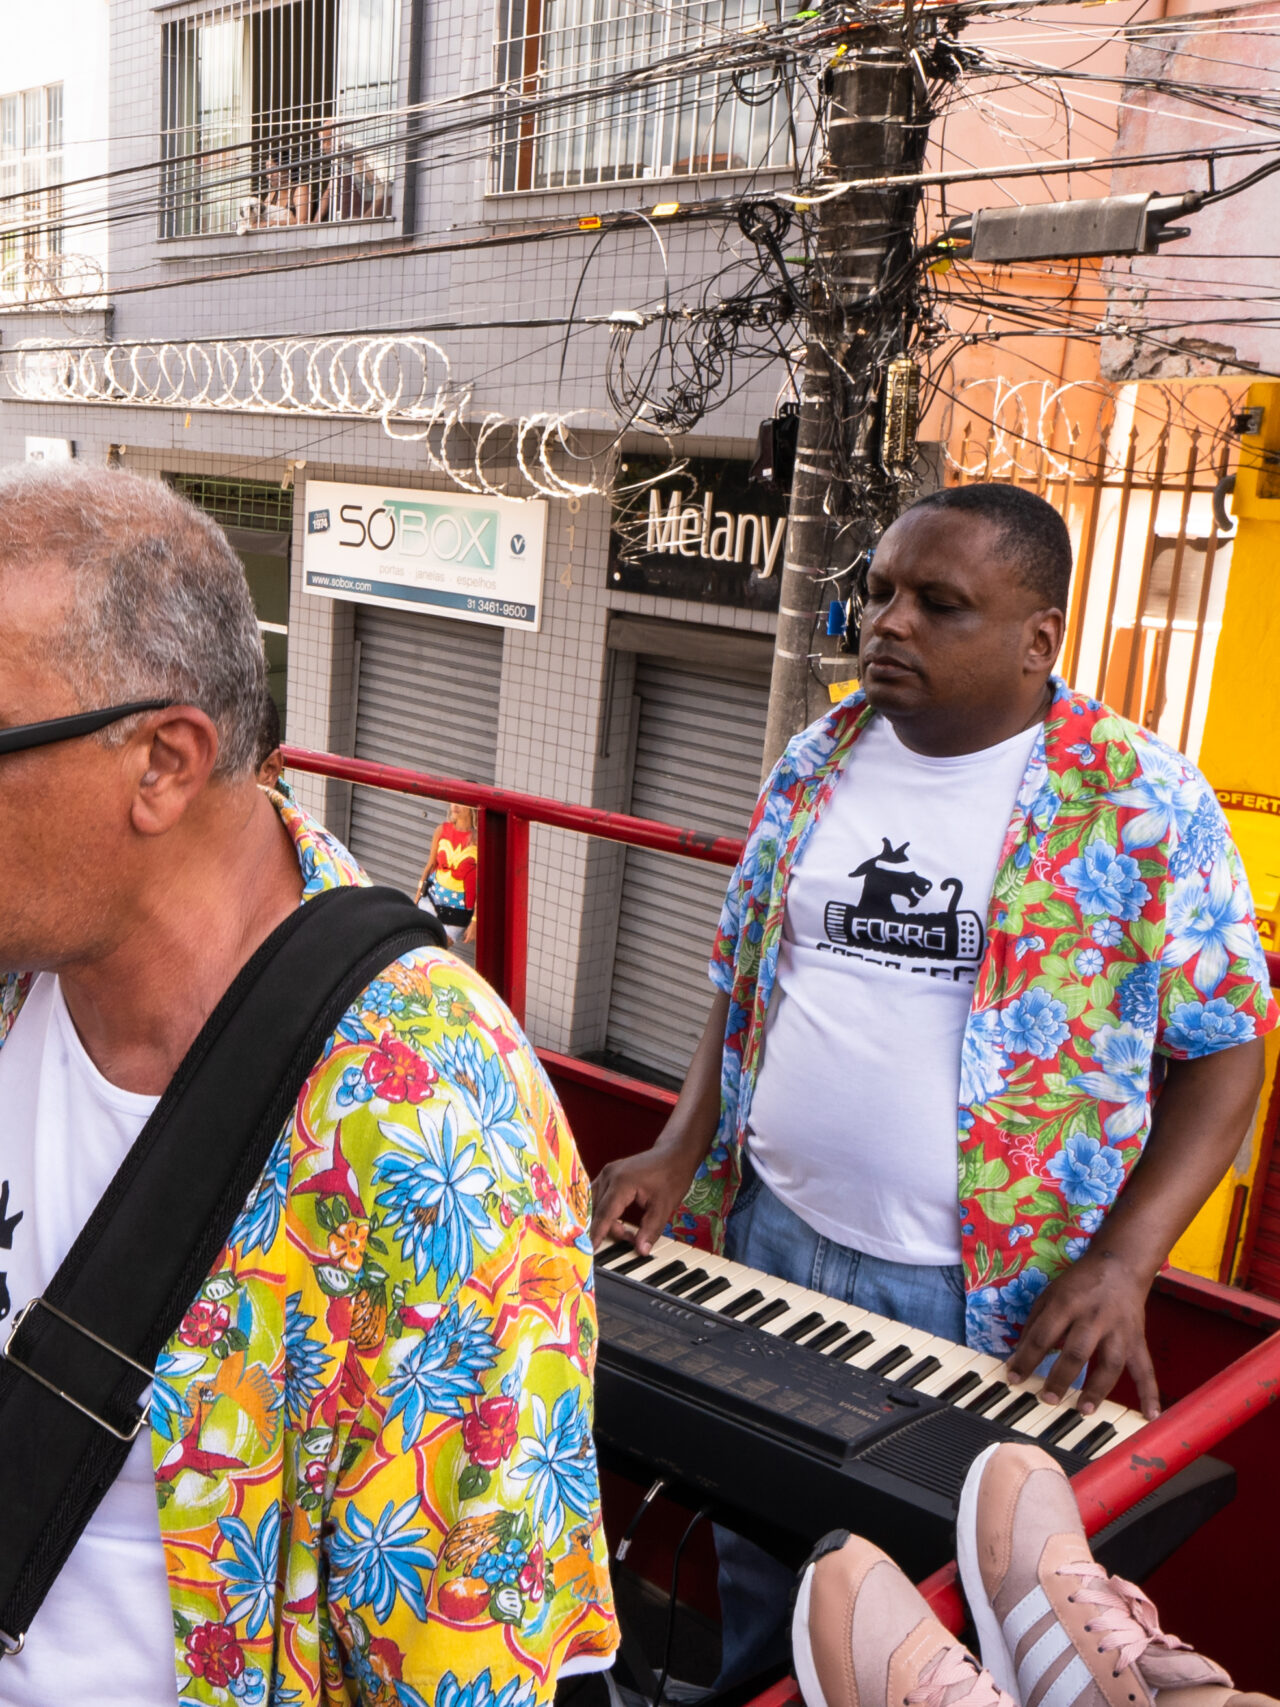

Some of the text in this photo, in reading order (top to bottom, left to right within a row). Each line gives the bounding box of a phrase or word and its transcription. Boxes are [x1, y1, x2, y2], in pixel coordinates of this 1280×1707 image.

[312, 518, 328, 530] 1974
[646, 489, 788, 580] Melany
[311, 575, 373, 592] www.sobox.com
[379, 565, 497, 591] portas janelas espelhos
[466, 598, 528, 619] 31 3461-9500
[1216, 790, 1280, 814] OFERT
[851, 917, 947, 951] FORRÓ
